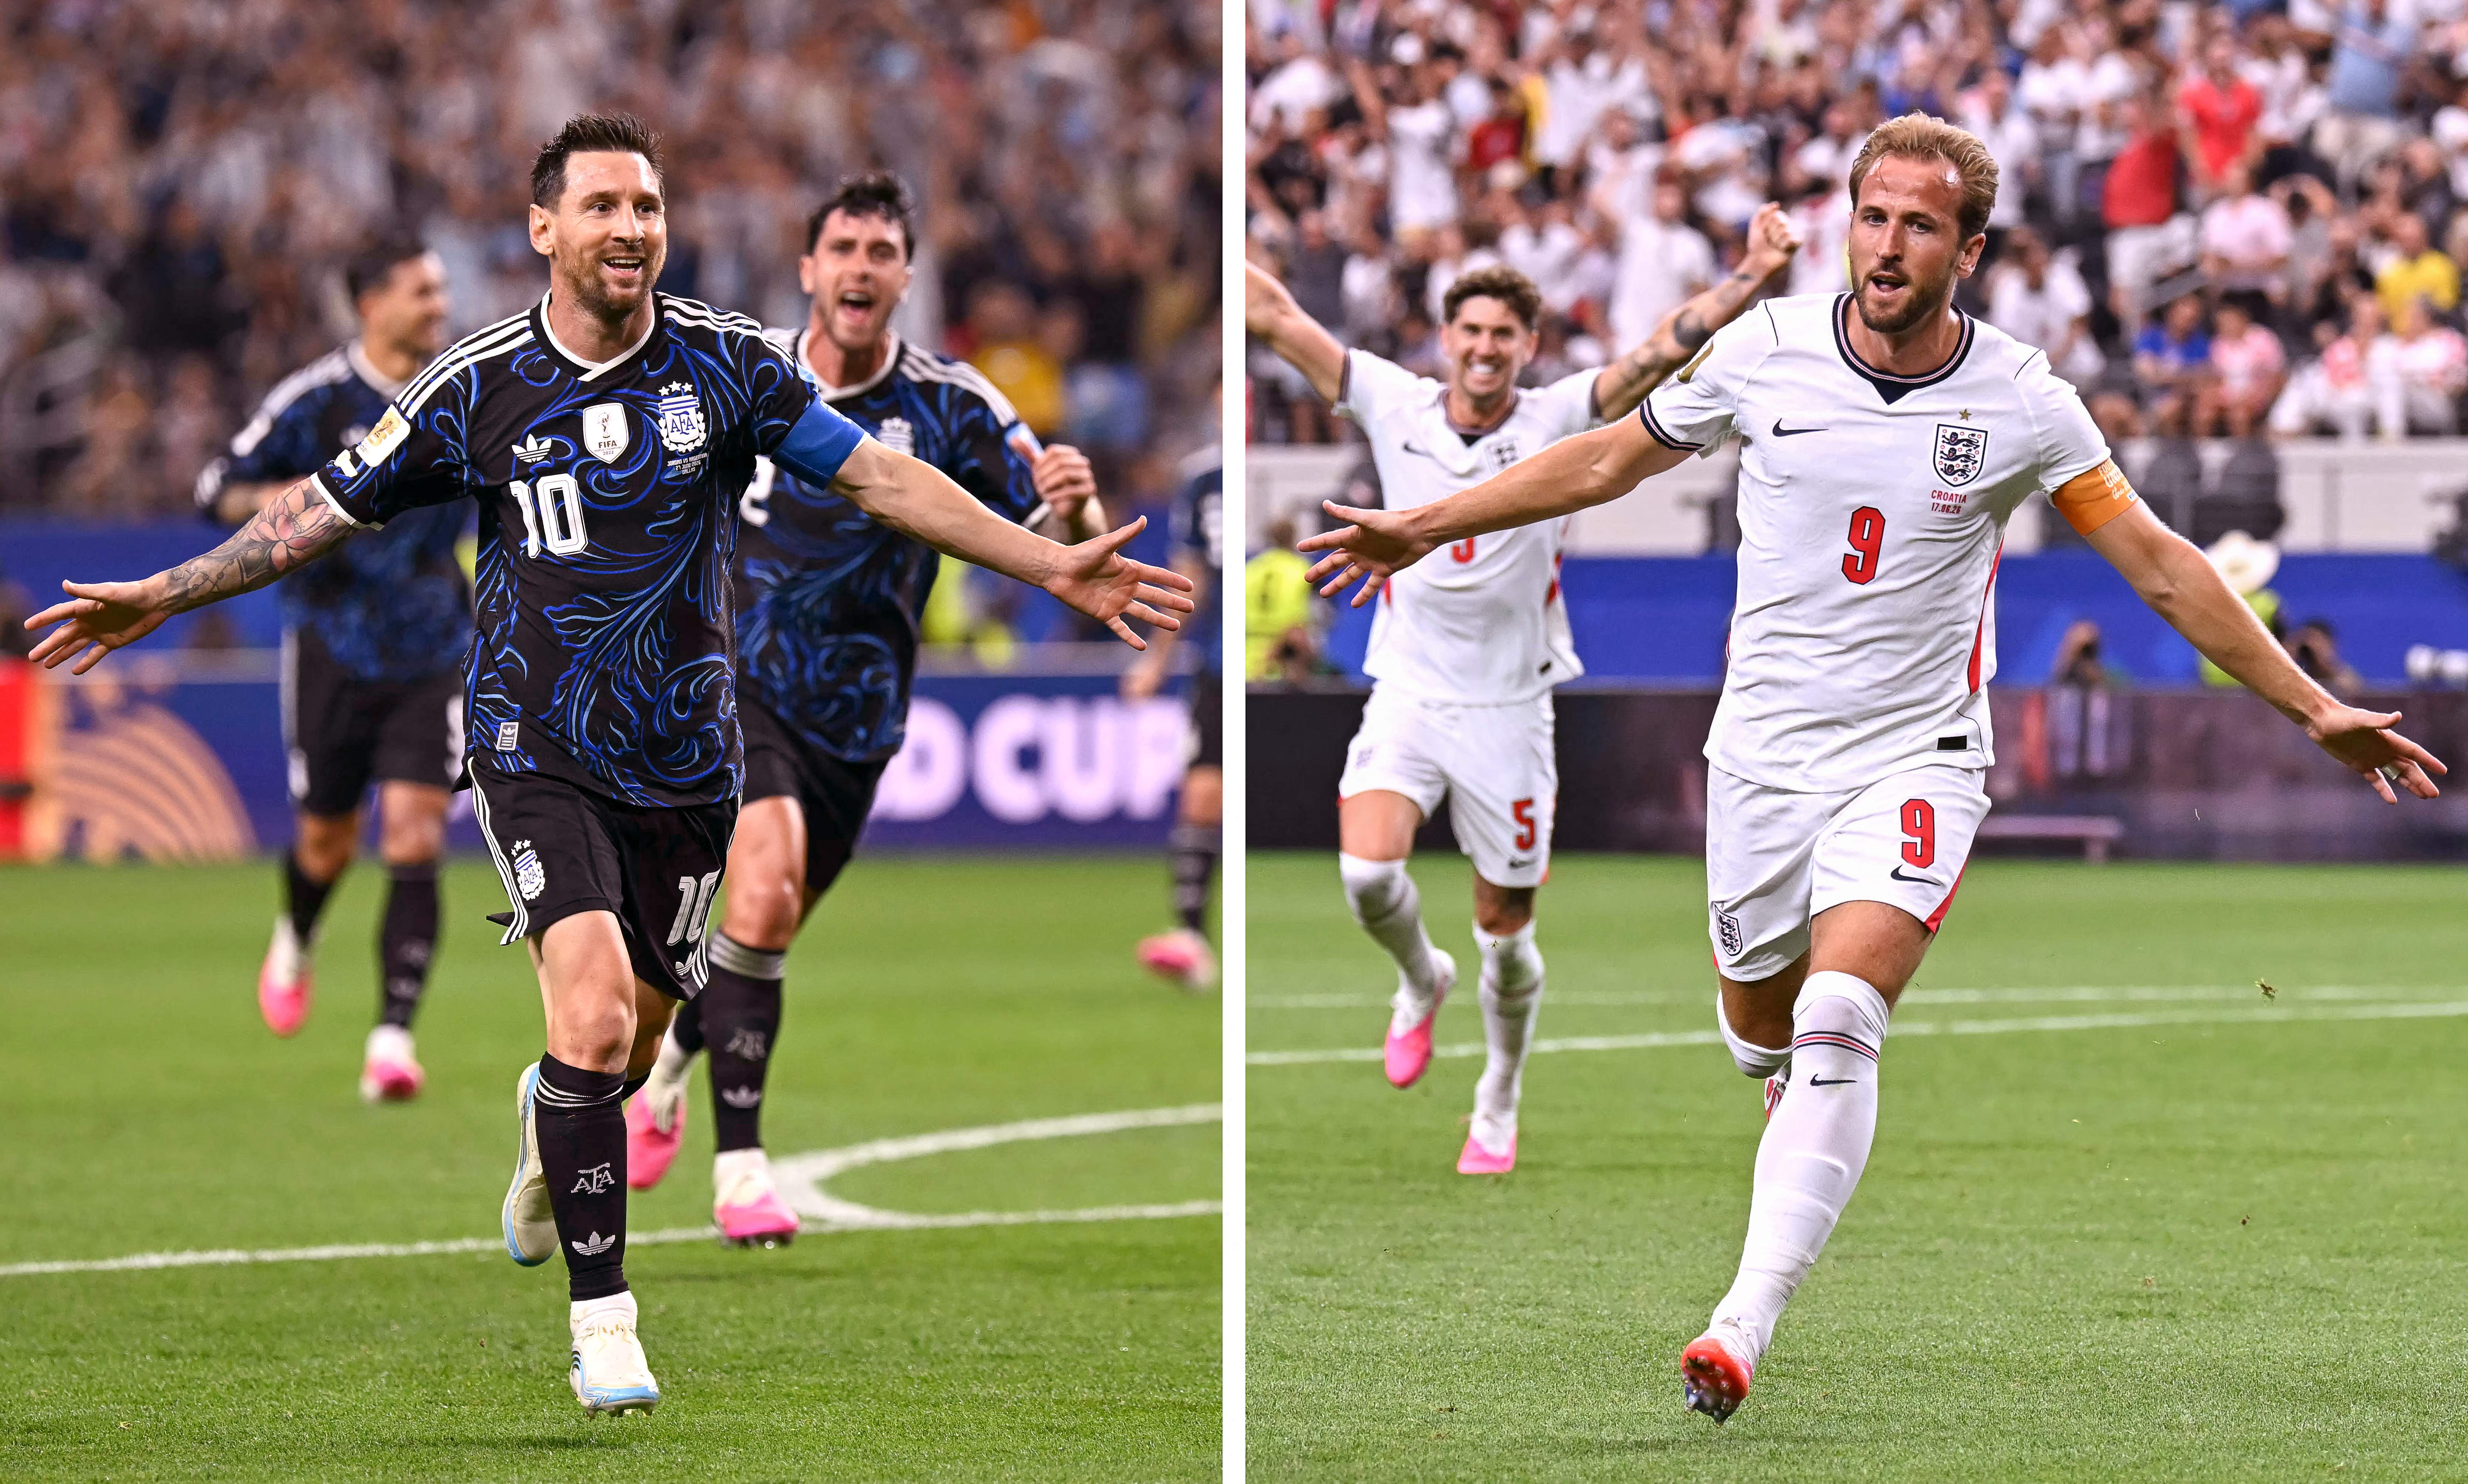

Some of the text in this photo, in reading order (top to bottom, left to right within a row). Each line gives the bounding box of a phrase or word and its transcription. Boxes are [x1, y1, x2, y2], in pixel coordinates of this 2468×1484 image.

[689, 453, 707, 462] ARGENTINA
[509, 473, 588, 558] 10
[1931, 490, 1967, 503] CROATIA
[1931, 503, 1962, 514] 17.06.26
[1842, 506, 1886, 585] 9
[971, 694, 1197, 824] CUP
[1512, 797, 1536, 851] 5
[1900, 799, 1935, 868] 9
